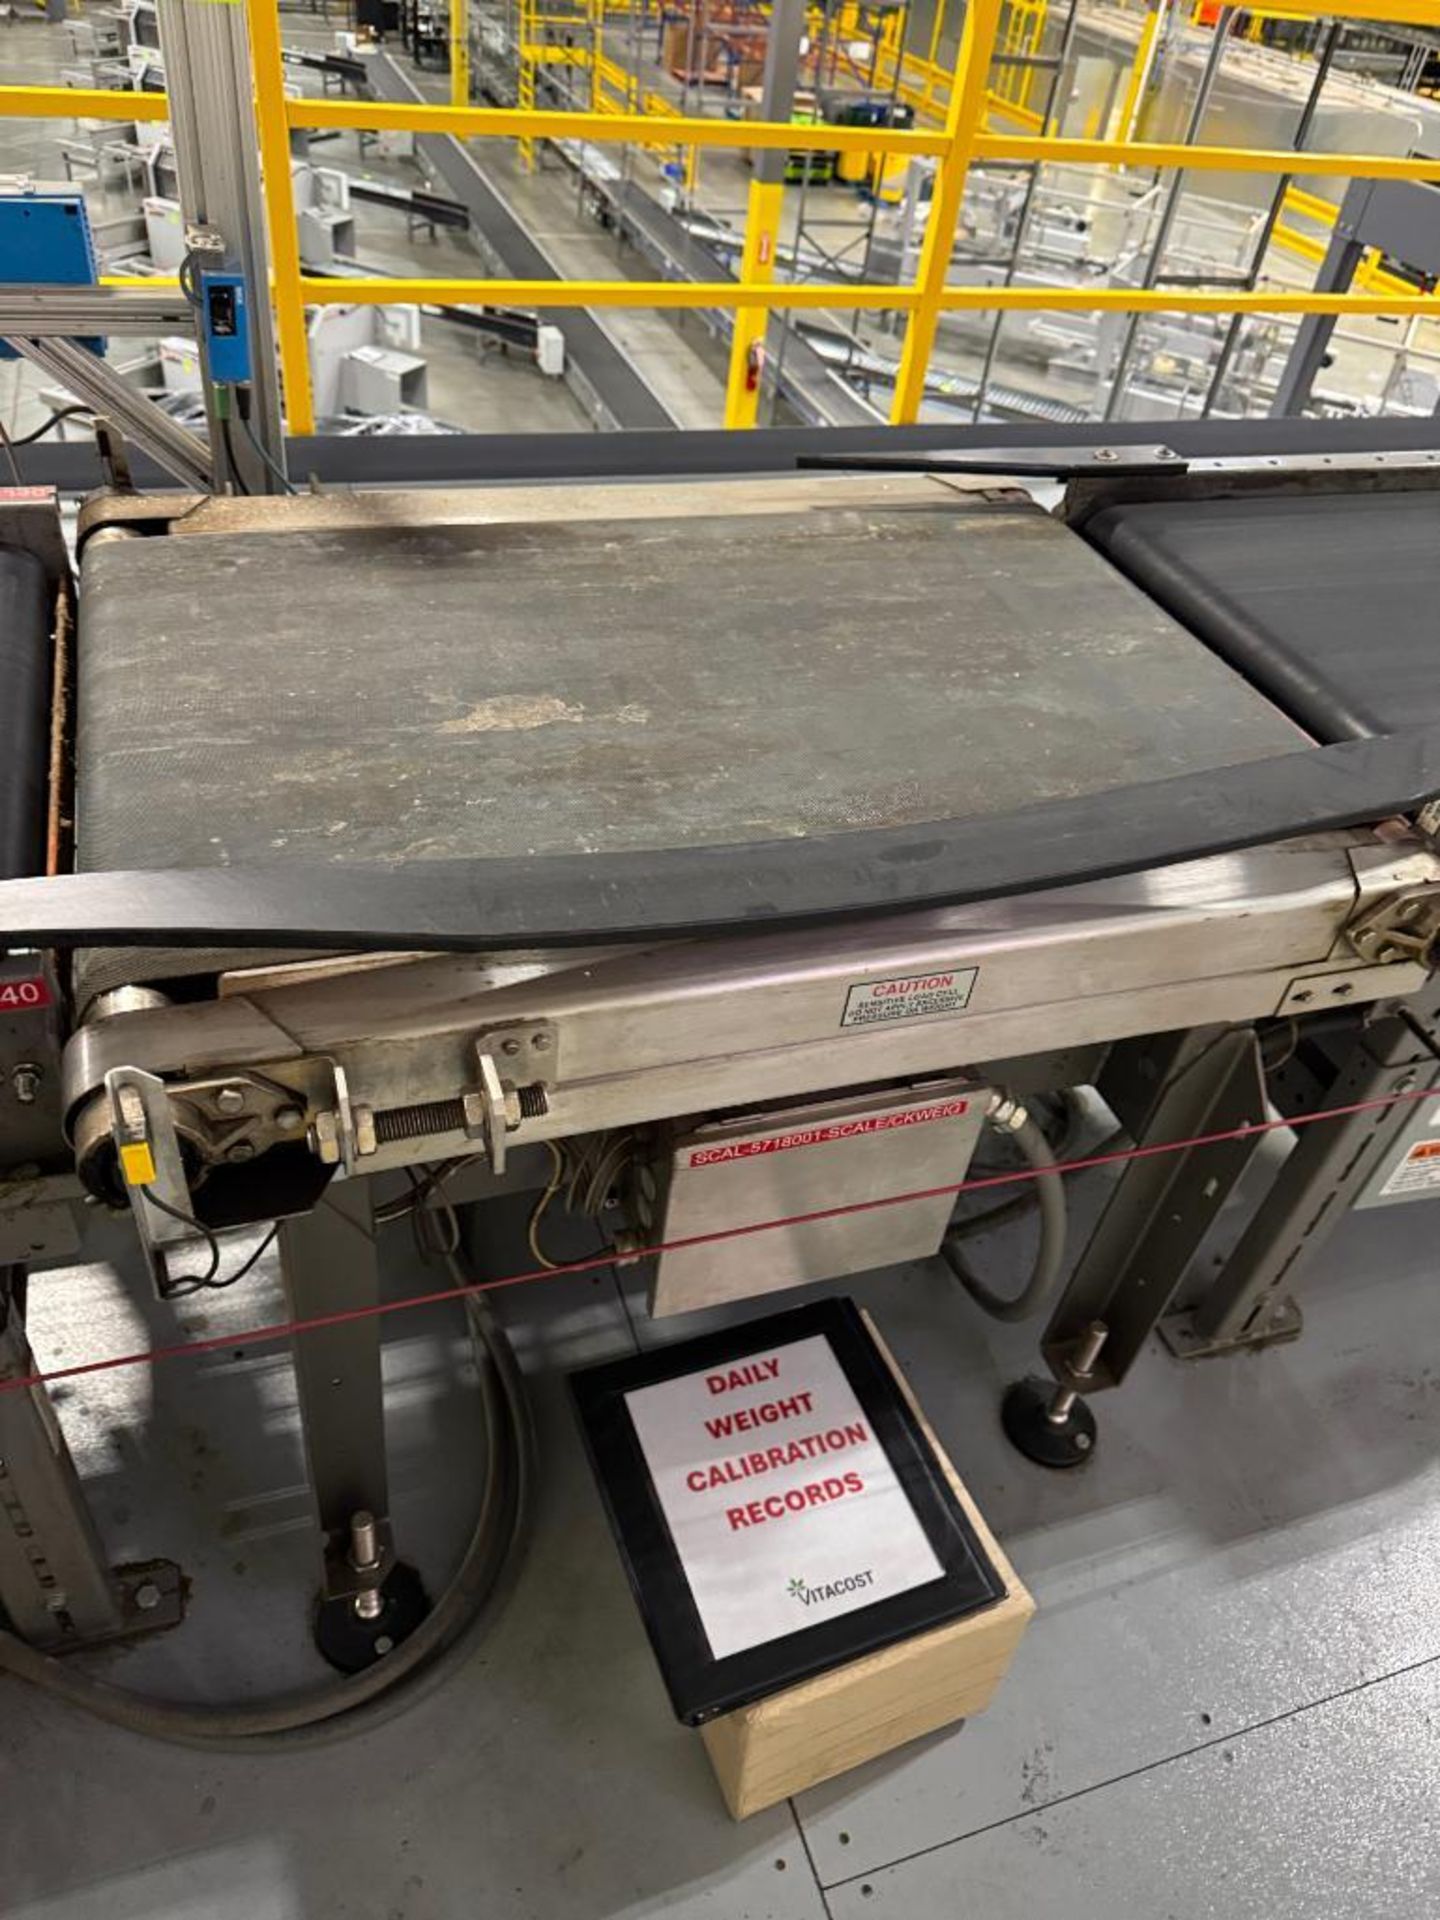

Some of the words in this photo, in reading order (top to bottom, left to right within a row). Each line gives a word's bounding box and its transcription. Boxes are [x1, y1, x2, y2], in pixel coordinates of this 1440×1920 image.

[0, 983, 39, 1005] 40
[872, 975, 955, 997] CAUTION
[705, 1357, 780, 1396] DAILY
[704, 1392, 814, 1440] WEIGHT
[686, 1422, 868, 1493] CALIBRATION
[726, 1472, 865, 1532] RECORDS
[797, 1569, 874, 1607] VITACOST
